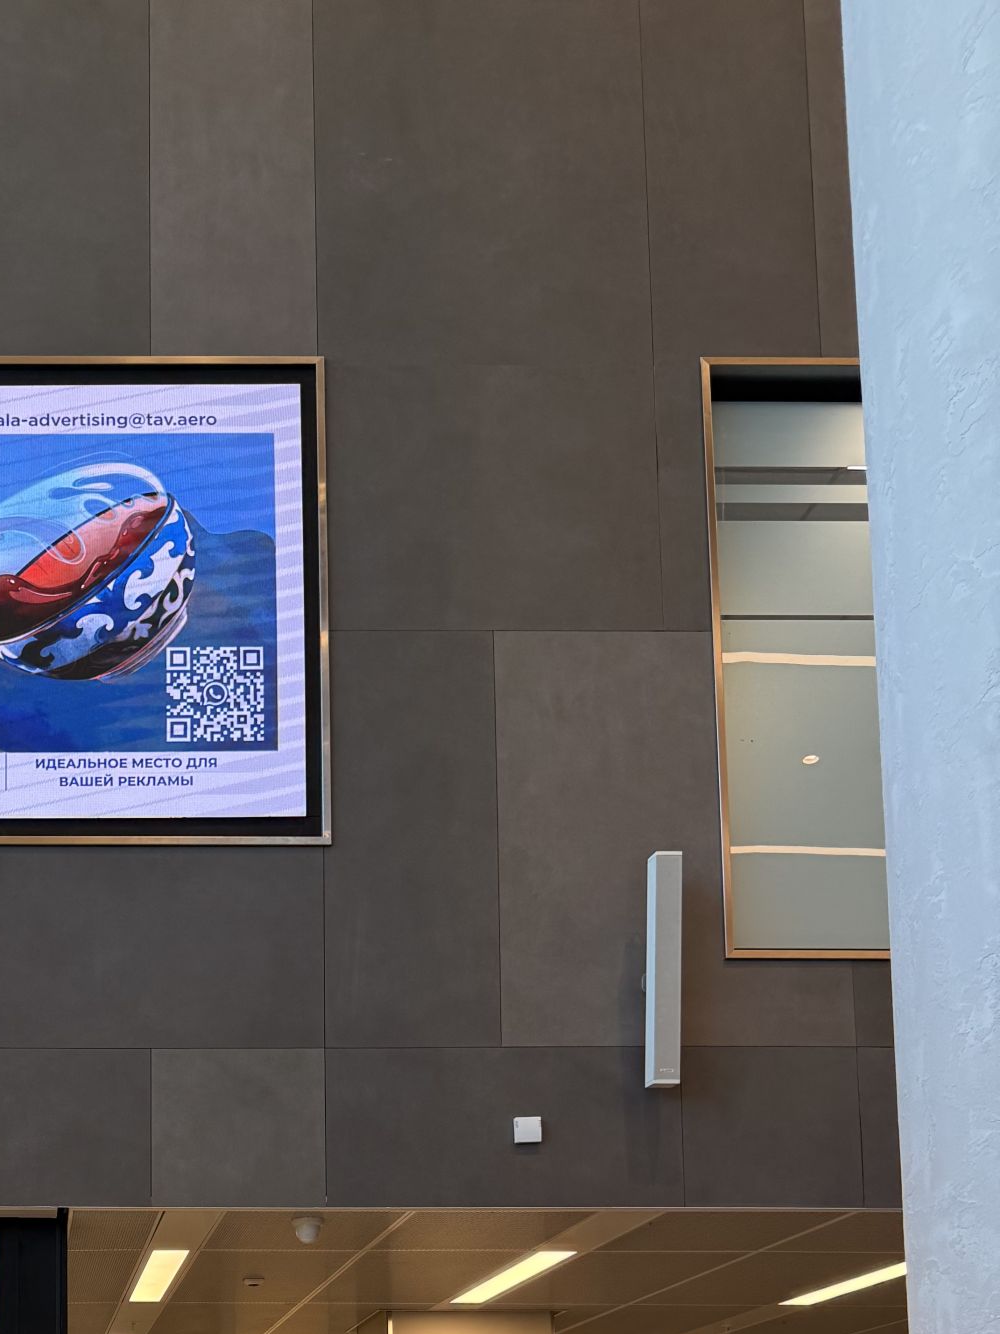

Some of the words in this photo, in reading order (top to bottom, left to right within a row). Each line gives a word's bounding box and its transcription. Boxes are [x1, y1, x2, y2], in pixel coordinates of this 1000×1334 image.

[35, 758, 128, 770] ИДЕАЛЬНОЕ
[132, 757, 182, 769] МЕСТО
[186, 757, 218, 770] ДЛЯ
[59, 774, 113, 787] ВАШЕЙ
[118, 775, 193, 787] РЕКЛАМЫ
